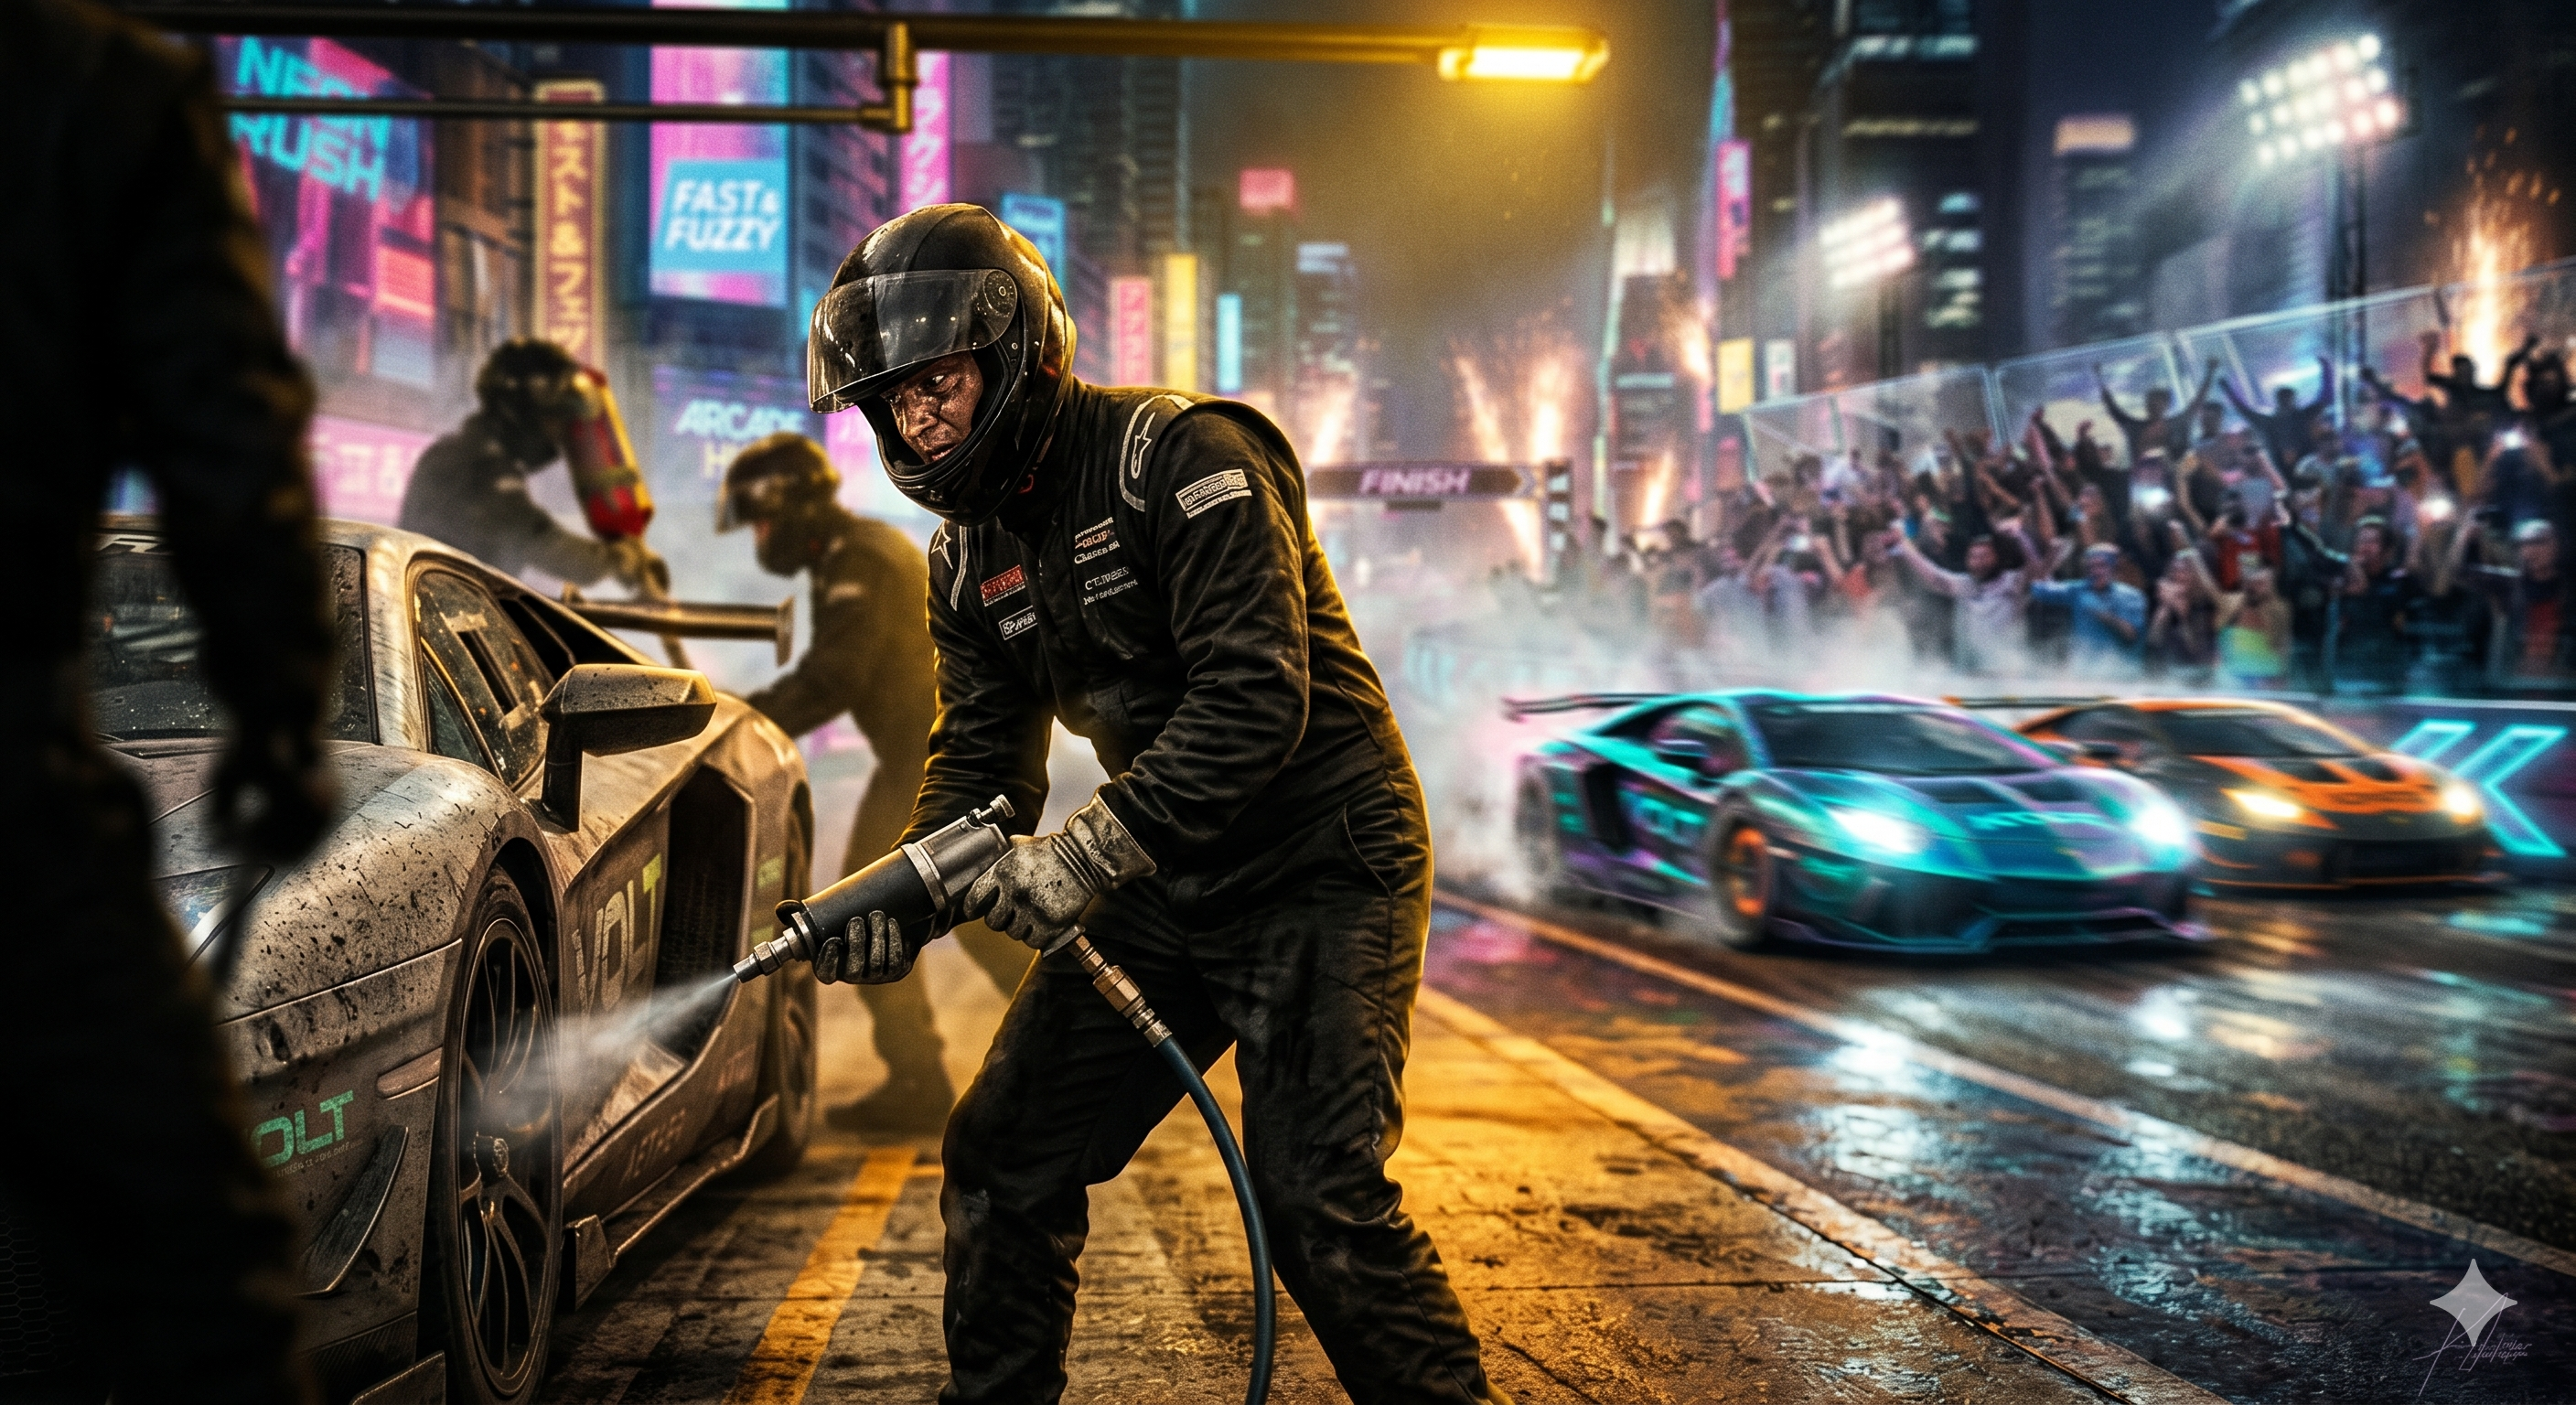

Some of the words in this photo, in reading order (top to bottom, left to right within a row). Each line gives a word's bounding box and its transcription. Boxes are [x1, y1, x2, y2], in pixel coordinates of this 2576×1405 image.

[229, 113, 385, 202] RUSH
[664, 216, 779, 252] FUZZY
[1358, 467, 1471, 495] FINISH
[250, 1089, 354, 1169] OLT
